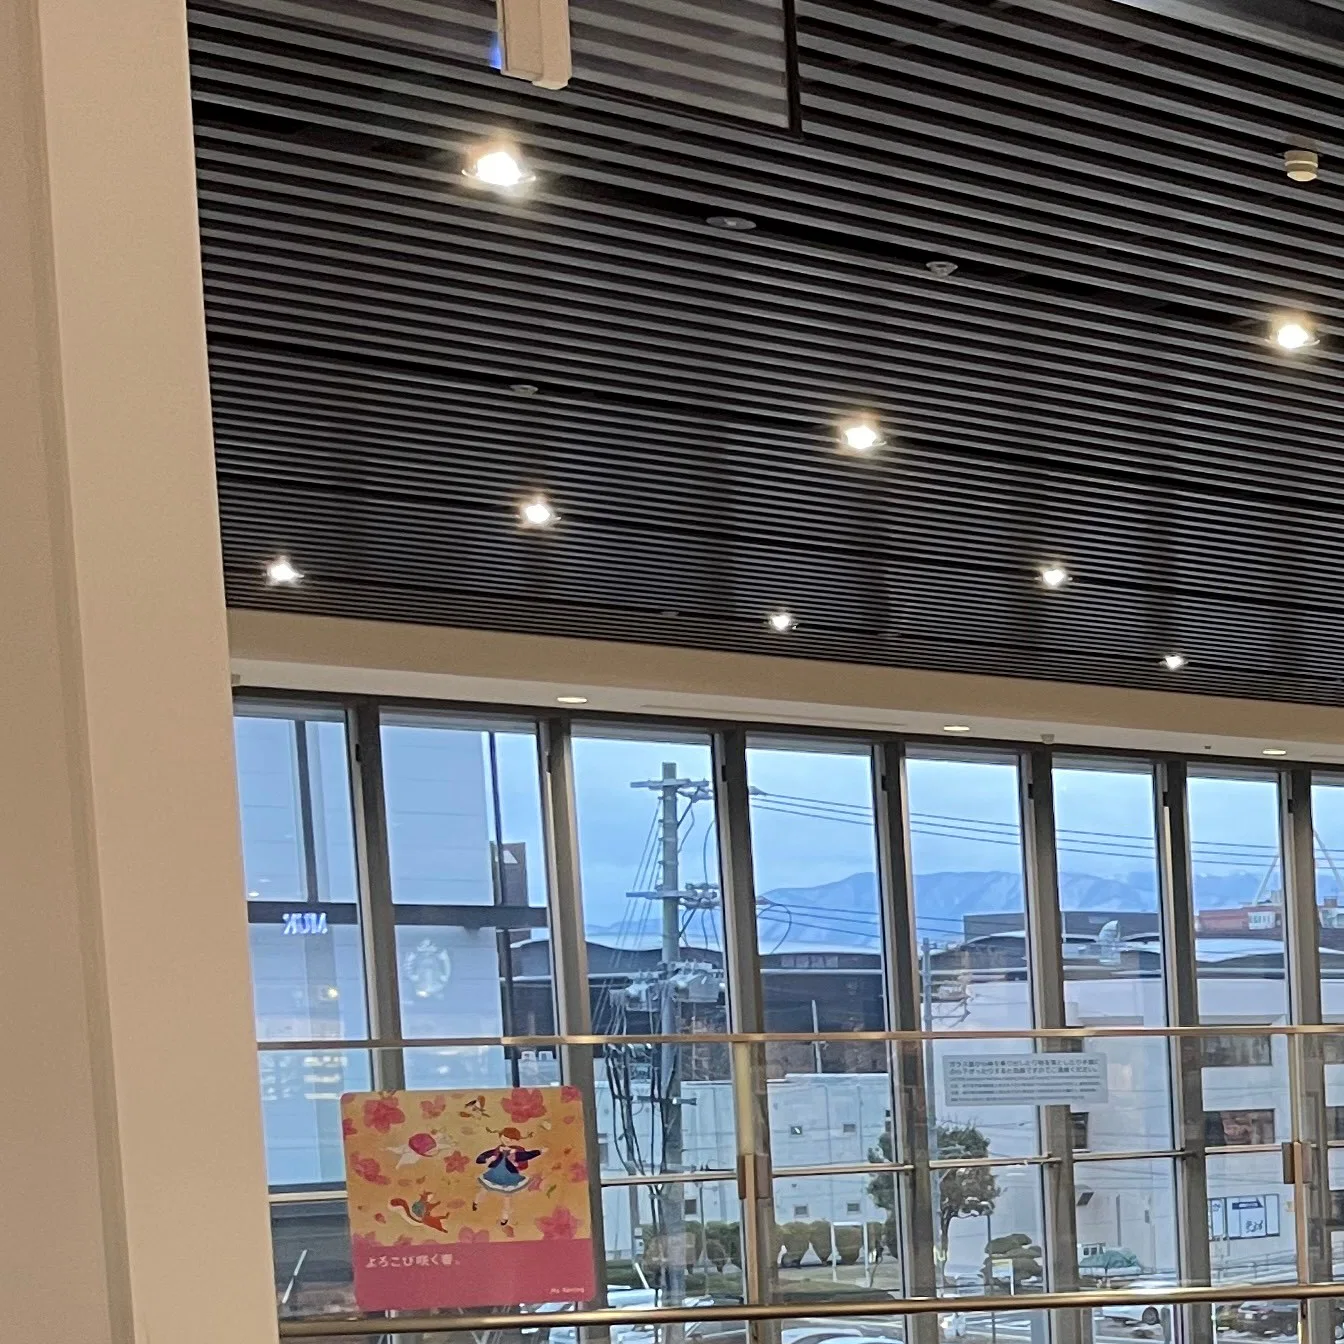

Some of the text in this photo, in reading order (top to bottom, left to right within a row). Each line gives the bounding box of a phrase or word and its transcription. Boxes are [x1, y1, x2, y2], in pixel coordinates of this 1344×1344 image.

[366, 1253, 461, 1269] よろこび咲く春。
